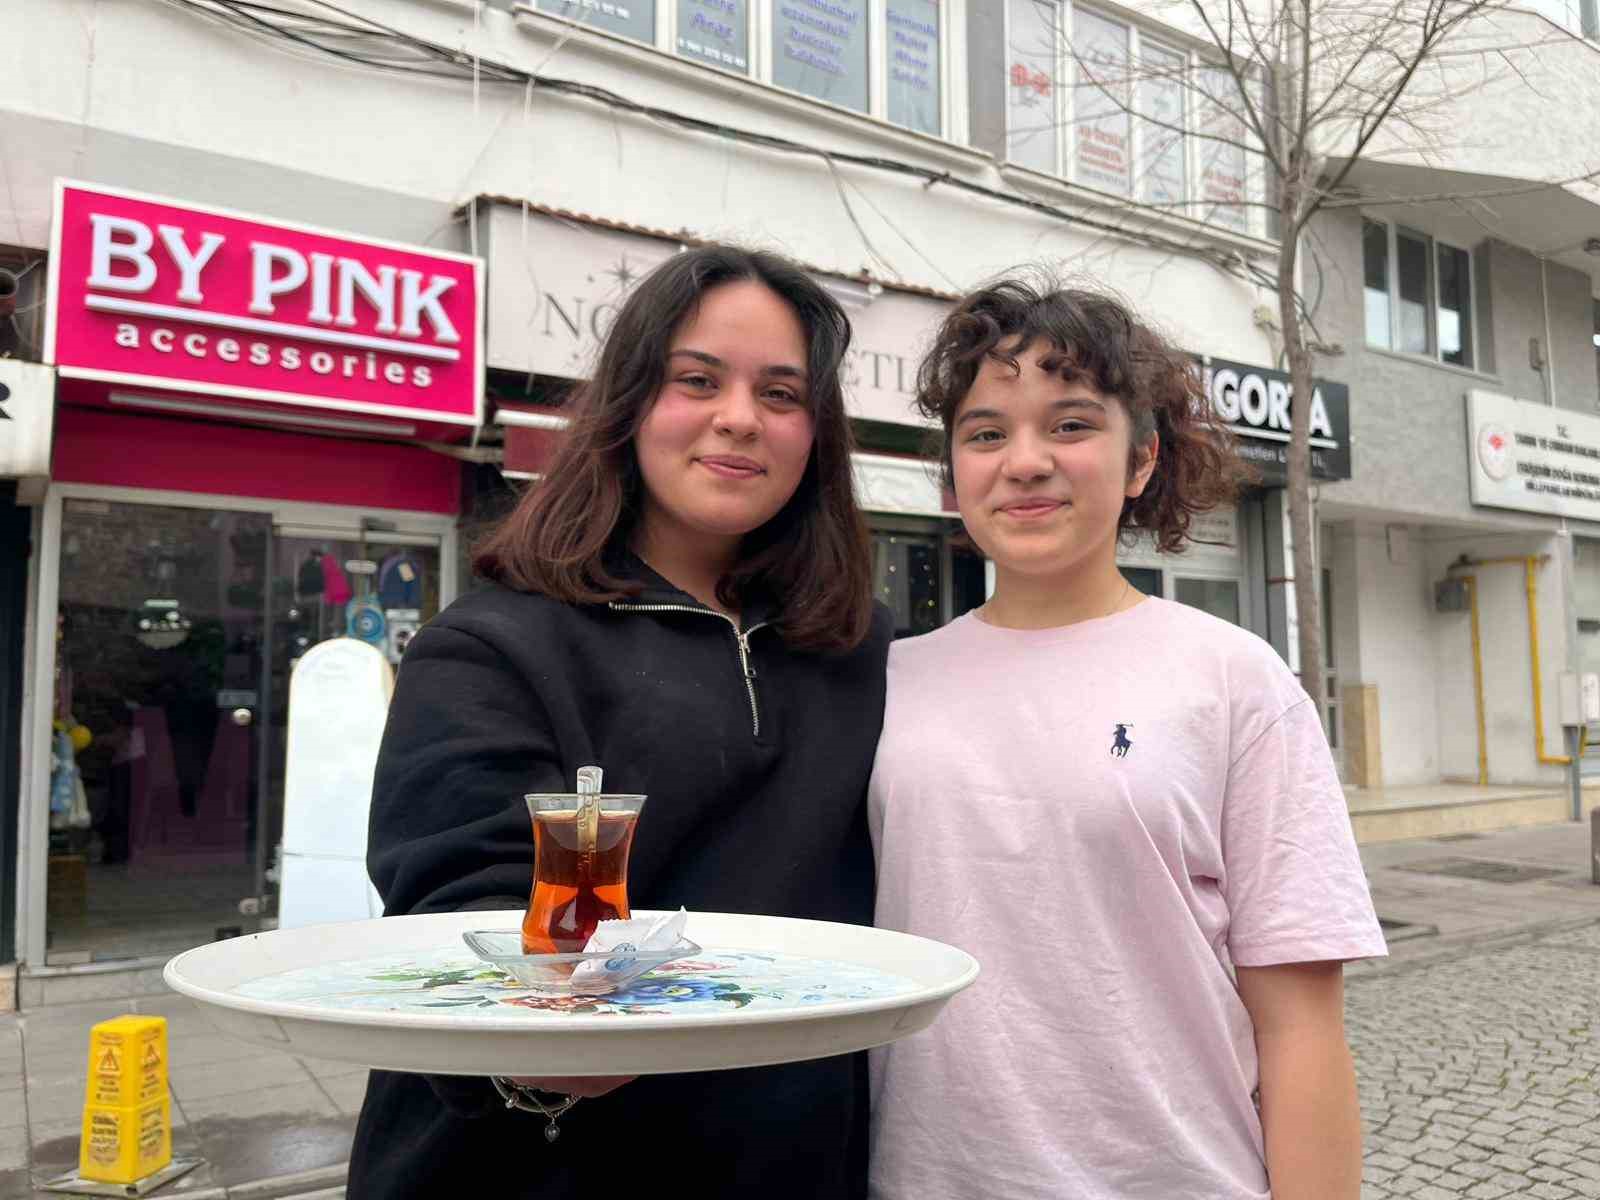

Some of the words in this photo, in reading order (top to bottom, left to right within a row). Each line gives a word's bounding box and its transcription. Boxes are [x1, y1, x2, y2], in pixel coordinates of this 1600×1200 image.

[86, 213, 225, 303] BY
[248, 241, 461, 343] PINK
[115, 322, 433, 388] accessories
